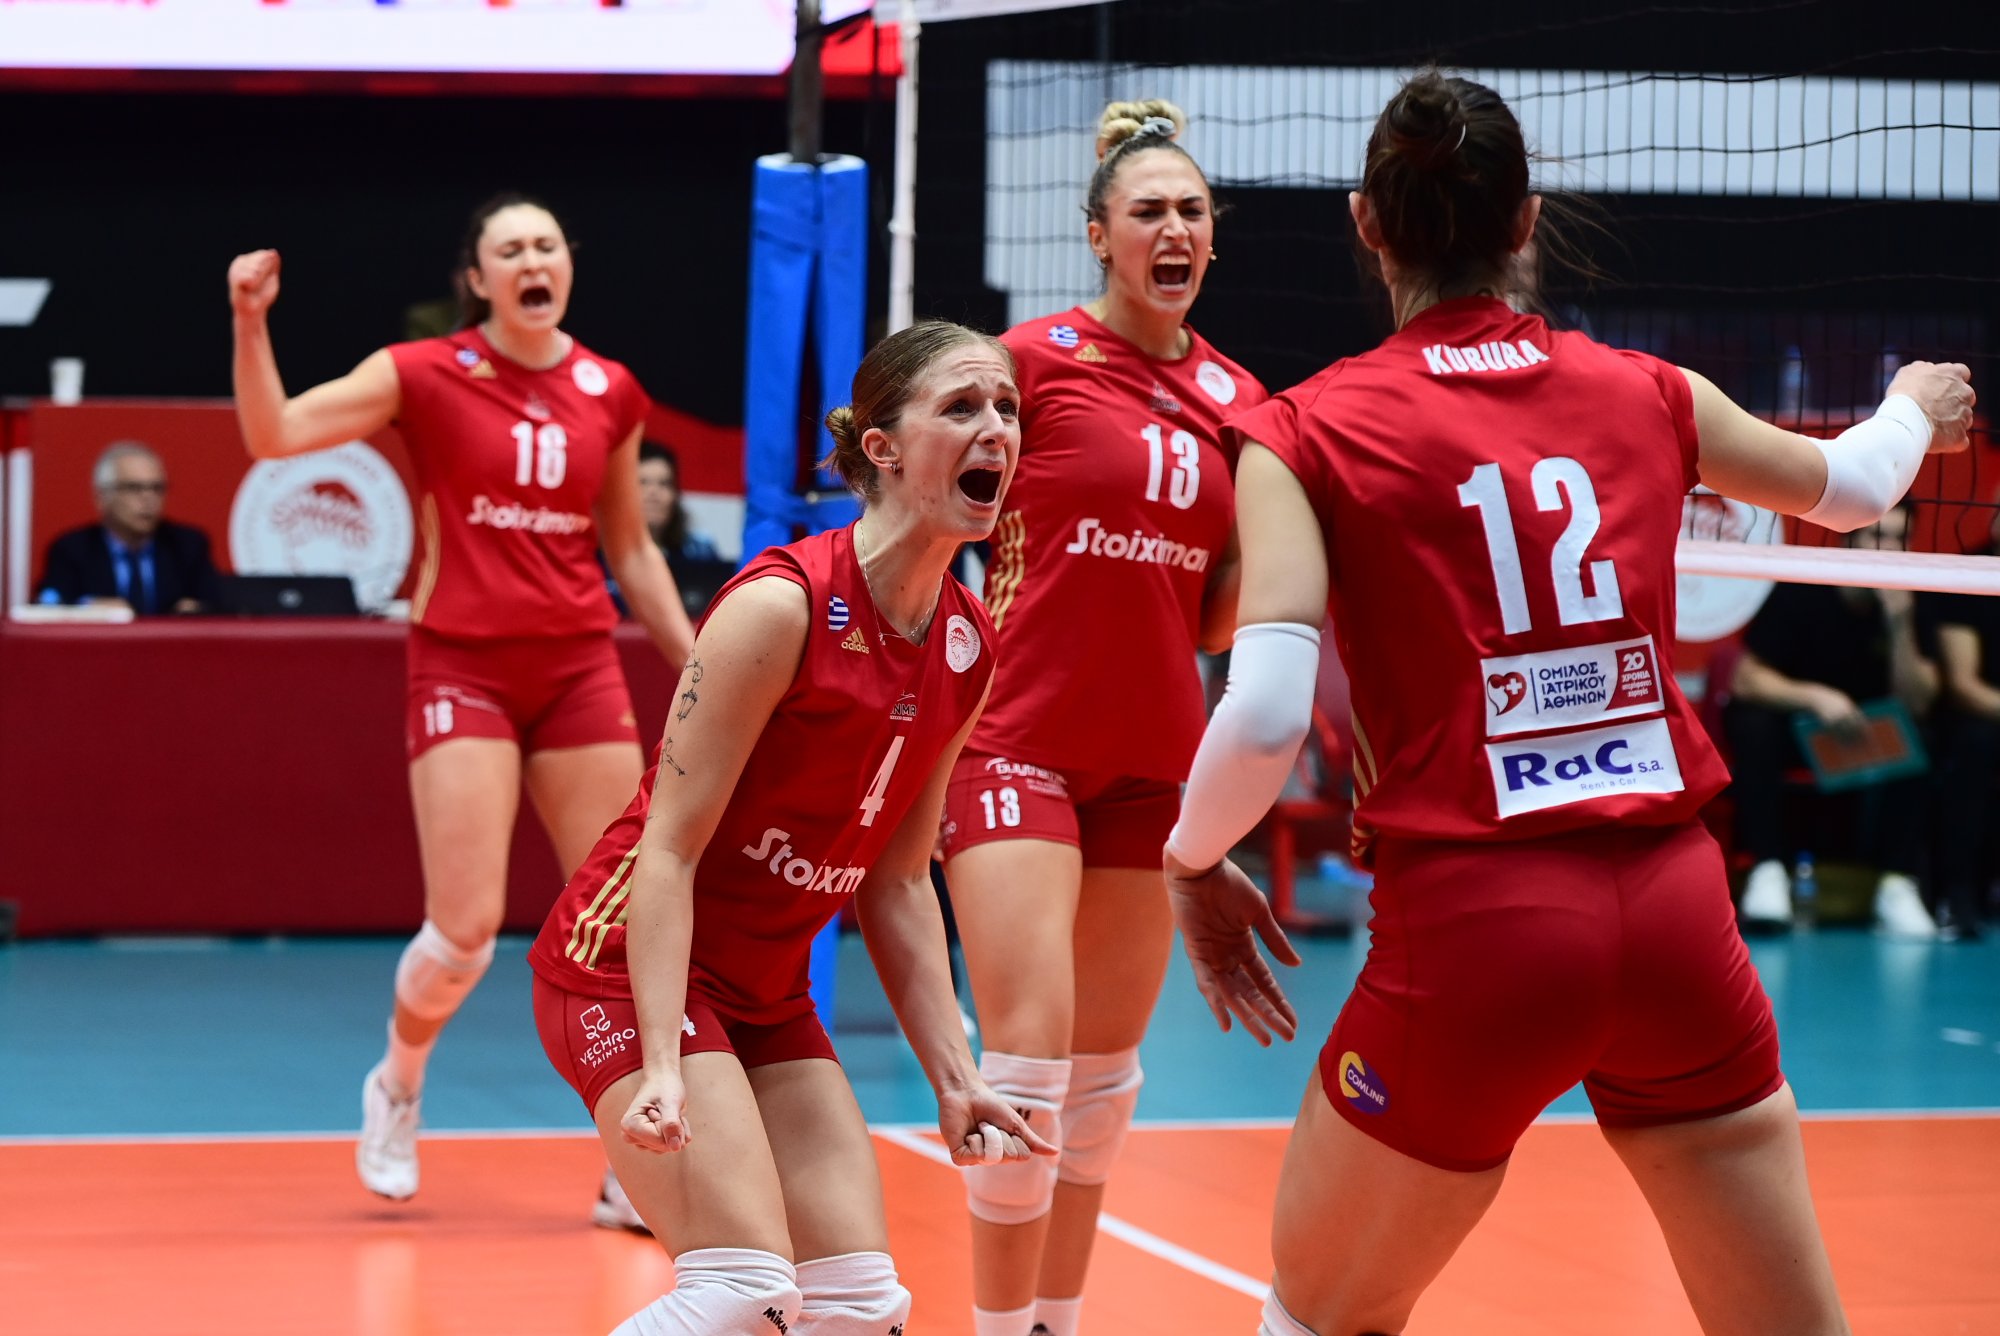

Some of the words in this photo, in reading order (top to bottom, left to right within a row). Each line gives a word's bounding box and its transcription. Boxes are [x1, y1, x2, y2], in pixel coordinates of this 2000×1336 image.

[1422, 339, 1550, 375] KUBURA
[510, 420, 567, 490] 18
[1140, 422, 1200, 510] 13
[1456, 456, 1625, 636] 12
[841, 641, 870, 654] adidas
[1623, 651, 1645, 672] 20
[1539, 662, 1598, 680] ΟΜΙΛΟΣ
[1541, 674, 1606, 695] ΙΑΤΡΙΚΟΥ
[1543, 689, 1606, 710] ΑΘΗΝΩΝ
[859, 736, 905, 827] 4
[1502, 739, 1634, 792] RaC
[1637, 759, 1664, 773] s.a.
[1580, 780, 1605, 791] Rent
[1619, 777, 1637, 786] Car
[979, 787, 1021, 830] 13
[580, 1028, 636, 1066] VECHRO
[592, 1043, 626, 1069] PAINTS
[1347, 1069, 1386, 1106] COMLINE
